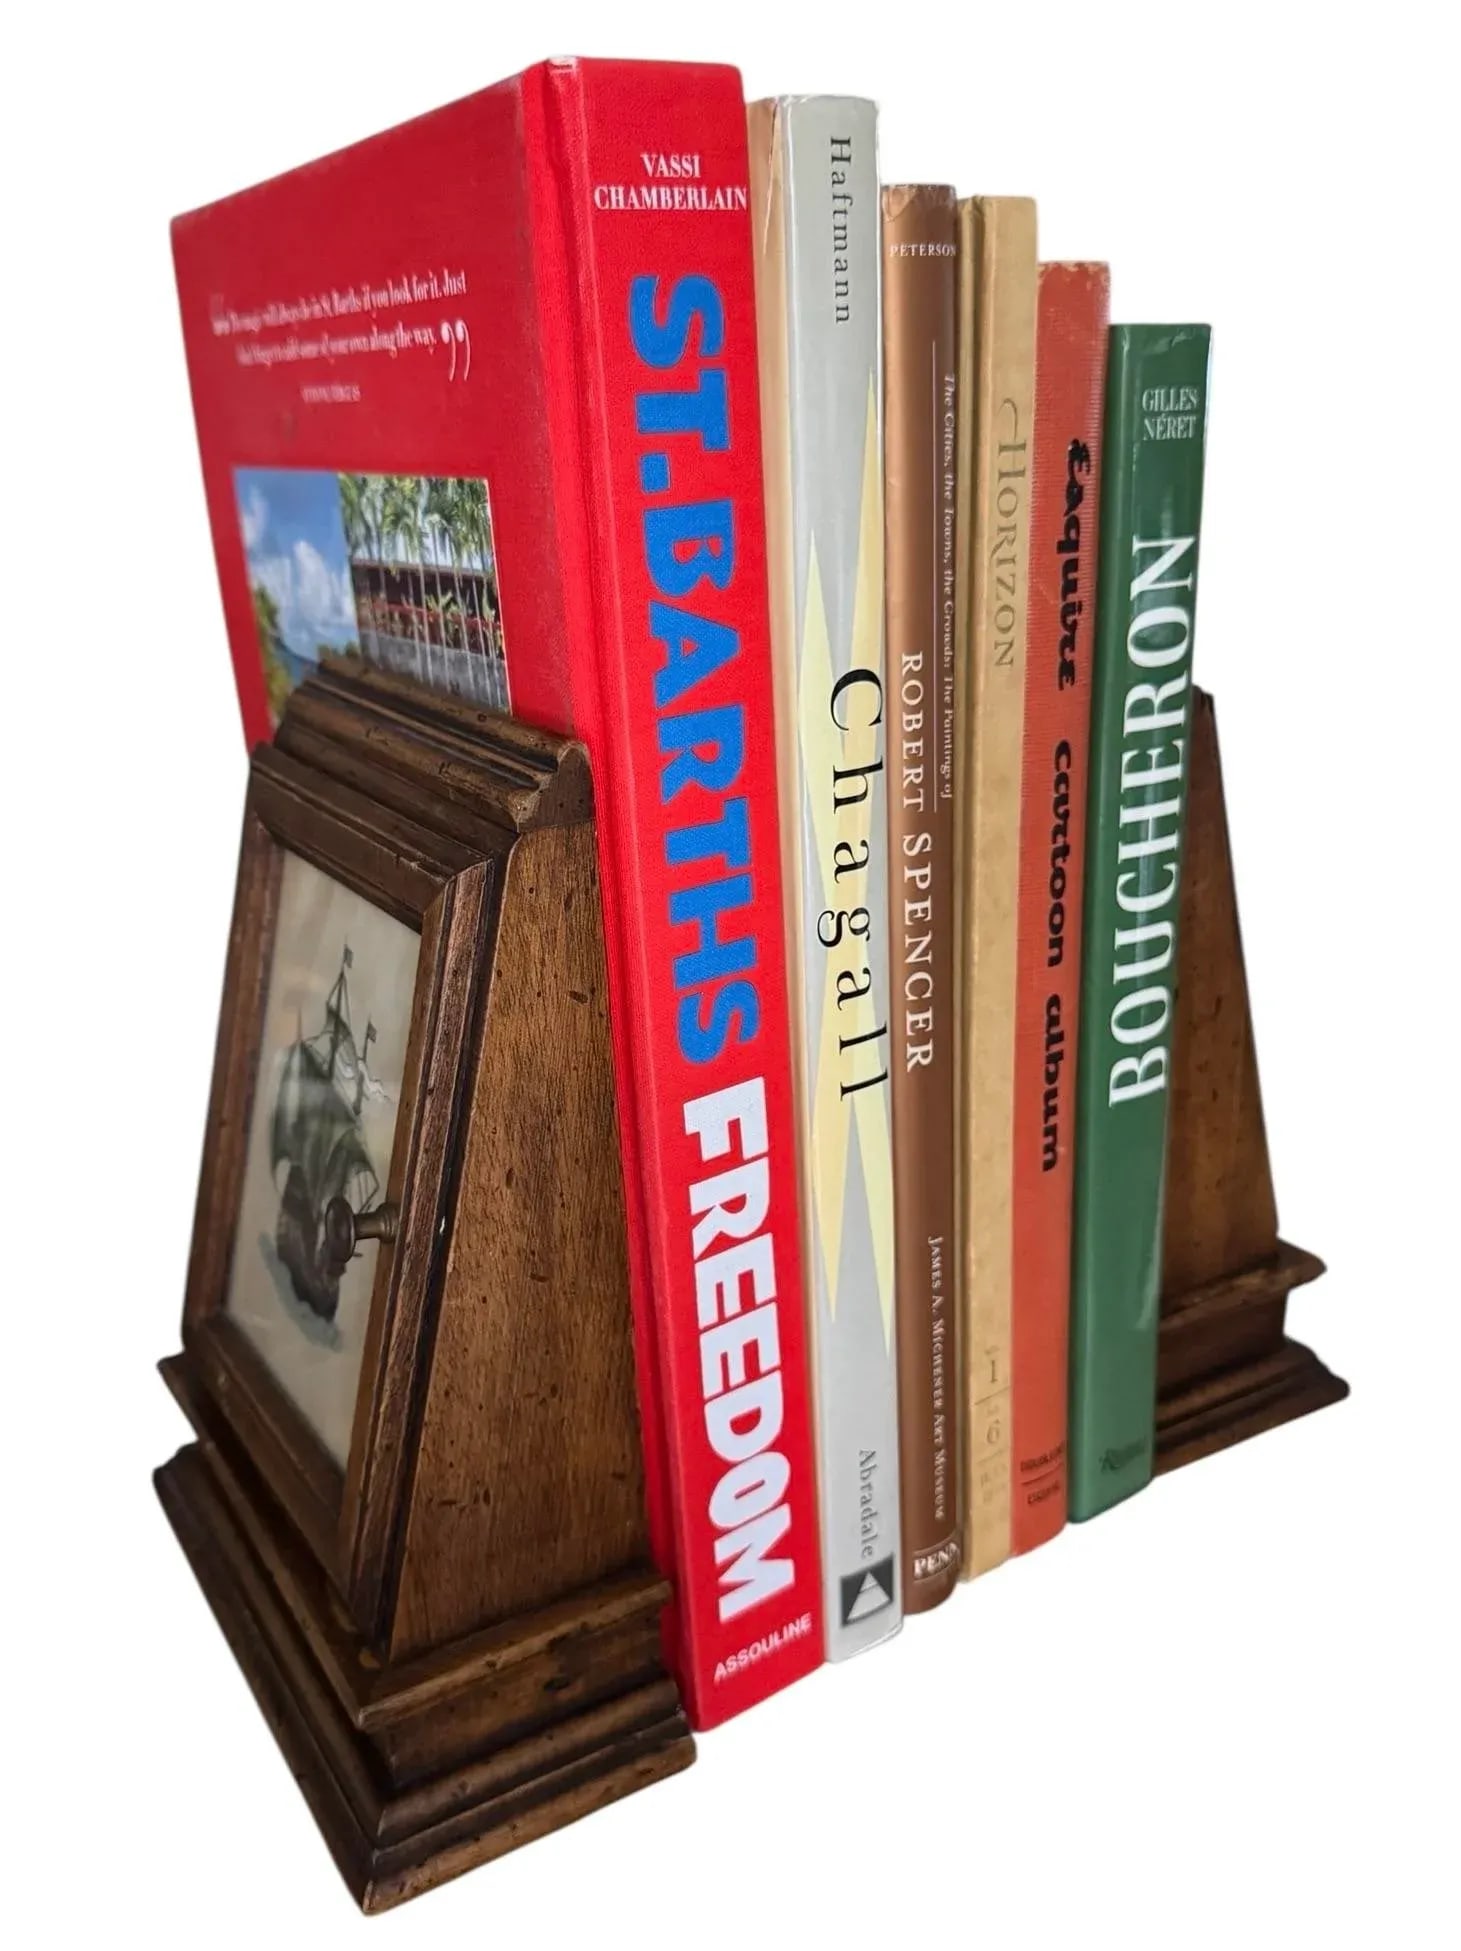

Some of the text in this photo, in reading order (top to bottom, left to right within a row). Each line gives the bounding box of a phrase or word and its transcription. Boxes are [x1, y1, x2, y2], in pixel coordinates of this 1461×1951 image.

[641, 152, 701, 178] VASSI
[594, 184, 747, 211] CHAMBERLAIN
[830, 136, 853, 323] Haftmann
[889, 243, 957, 258] PETERSON
[386, 273, 413, 307] look
[411, 272, 428, 302] for
[428, 268, 442, 300] it.
[441, 266, 467, 297] Just
[395, 320, 413, 348] the
[412, 328, 437, 355] way.
[944, 374, 955, 406] The
[1142, 388, 1198, 412] GILLES
[1143, 412, 1197, 441] NÉRET
[944, 474, 954, 499] the
[990, 398, 1027, 668] HORIZON
[943, 570, 954, 595] the
[943, 677, 953, 704] The
[940, 709, 953, 780] Paintings
[940, 784, 953, 799] of
[1108, 534, 1197, 1108] BOUCHERON
[901, 652, 934, 1073] ROBERT SPENCER
[1047, 739, 1071, 968] cartoon
[817, 668, 889, 1101] Chagall
[1042, 993, 1065, 1172] album
[928, 1236, 944, 1289] JAMES
[683, 1075, 796, 1622] FREEDOM
[858, 1449, 879, 1559] Abradale
[713, 1612, 812, 1686] ASSOULINE
